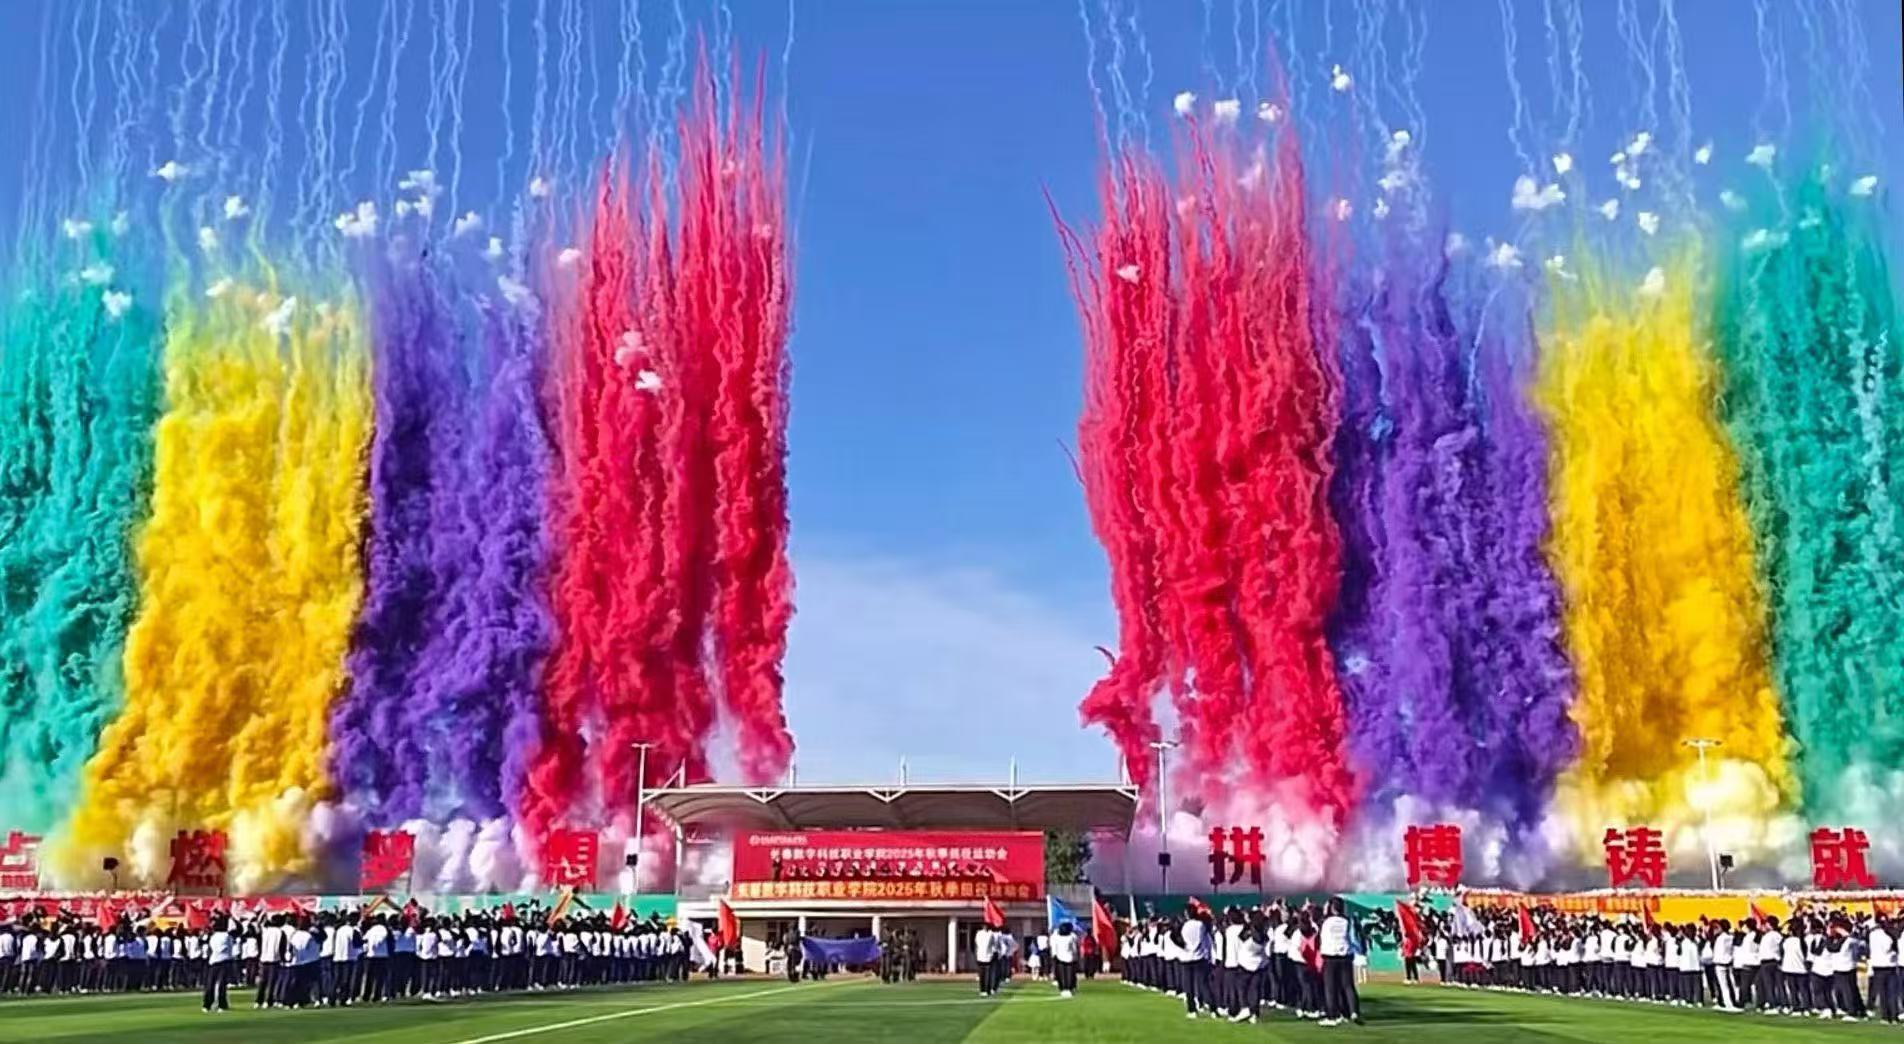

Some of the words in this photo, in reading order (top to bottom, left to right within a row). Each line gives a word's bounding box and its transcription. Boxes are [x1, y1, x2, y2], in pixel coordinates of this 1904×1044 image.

[546, 829, 598, 888] 想
[1209, 826, 1266, 885] 拼
[1403, 824, 1463, 886] 搏
[1603, 826, 1668, 888] 铸
[1809, 827, 1877, 889] 就
